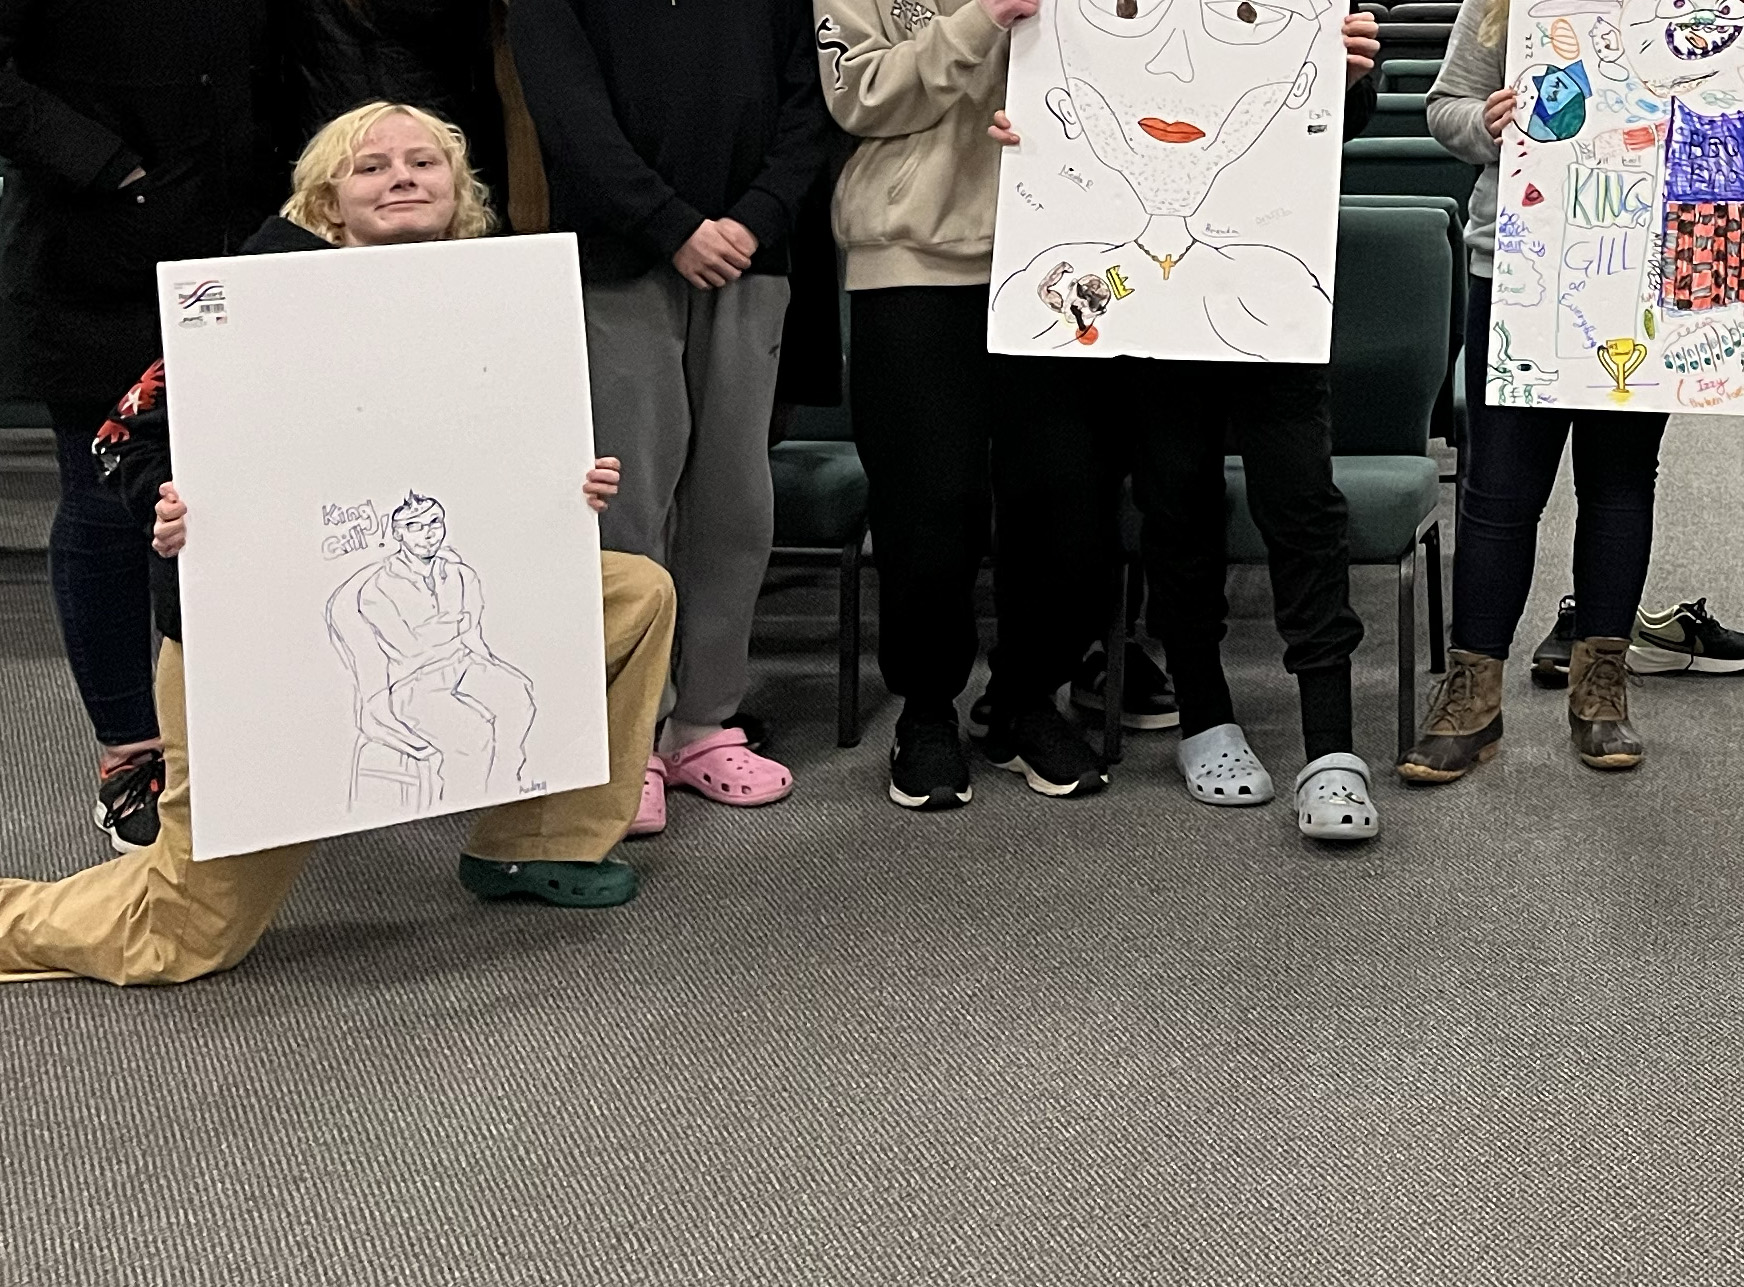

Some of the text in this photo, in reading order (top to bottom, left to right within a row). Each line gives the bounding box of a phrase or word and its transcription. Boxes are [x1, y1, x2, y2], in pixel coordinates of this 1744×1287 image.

[1572, 168, 1652, 225] KING
[1564, 231, 1636, 278] GILL
[1695, 377, 1730, 395] Izzy
[322, 499, 379, 535] King
